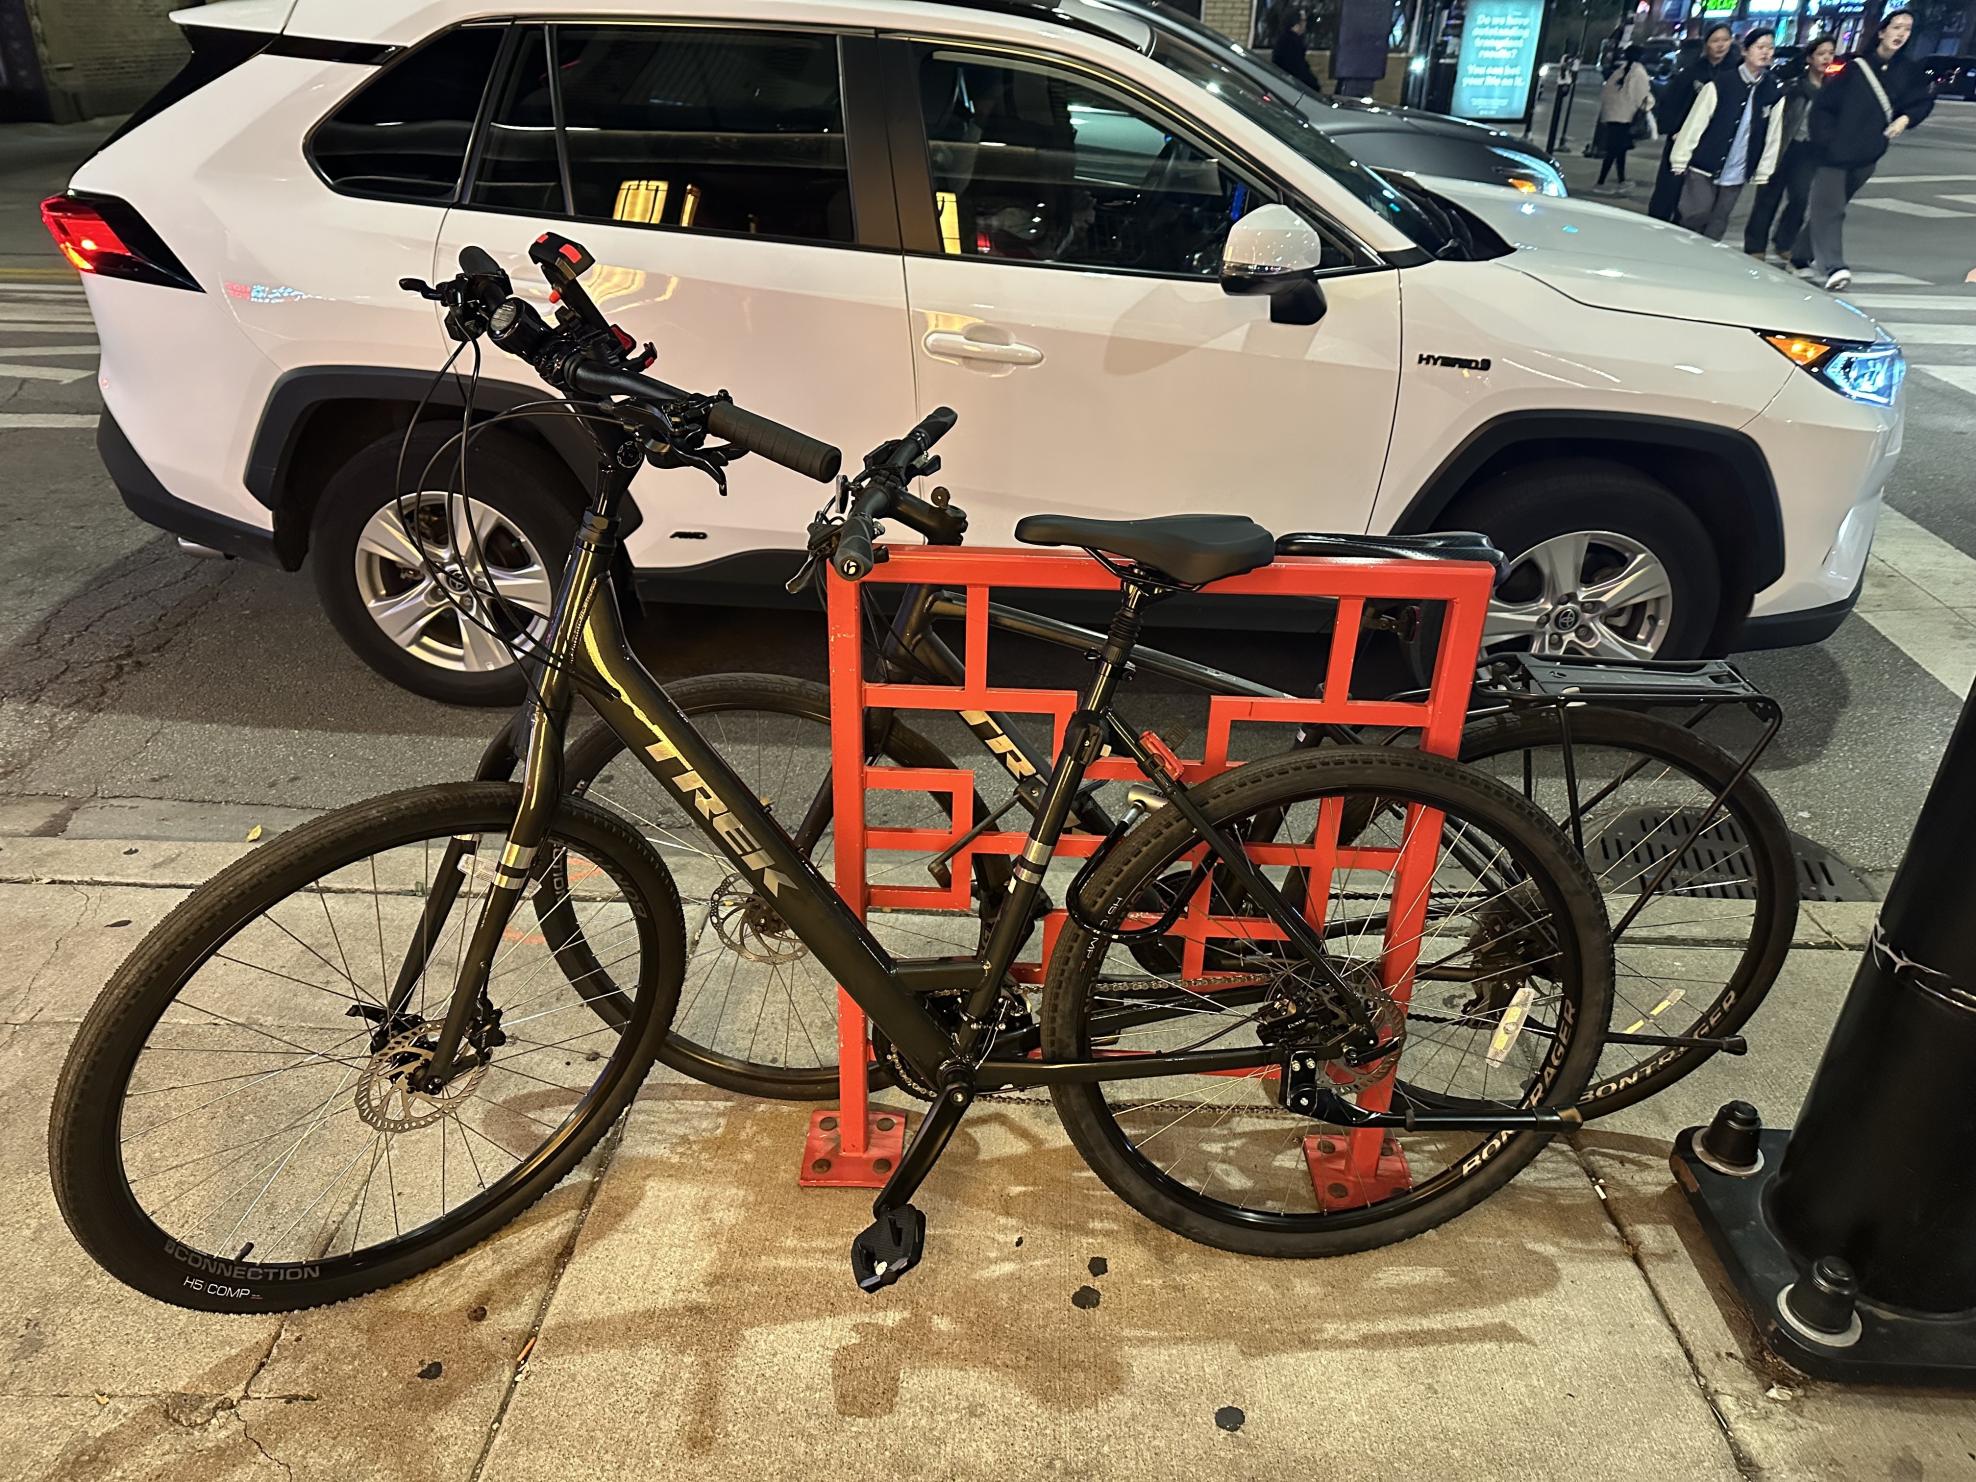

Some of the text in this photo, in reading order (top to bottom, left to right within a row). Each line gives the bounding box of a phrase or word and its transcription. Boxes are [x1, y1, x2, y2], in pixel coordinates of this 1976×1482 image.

[645, 724, 799, 898] TREK
[1579, 990, 1736, 1105] BONTRGER
[173, 1246, 320, 1281] CONNECTION
[207, 1283, 250, 1299] COMP
